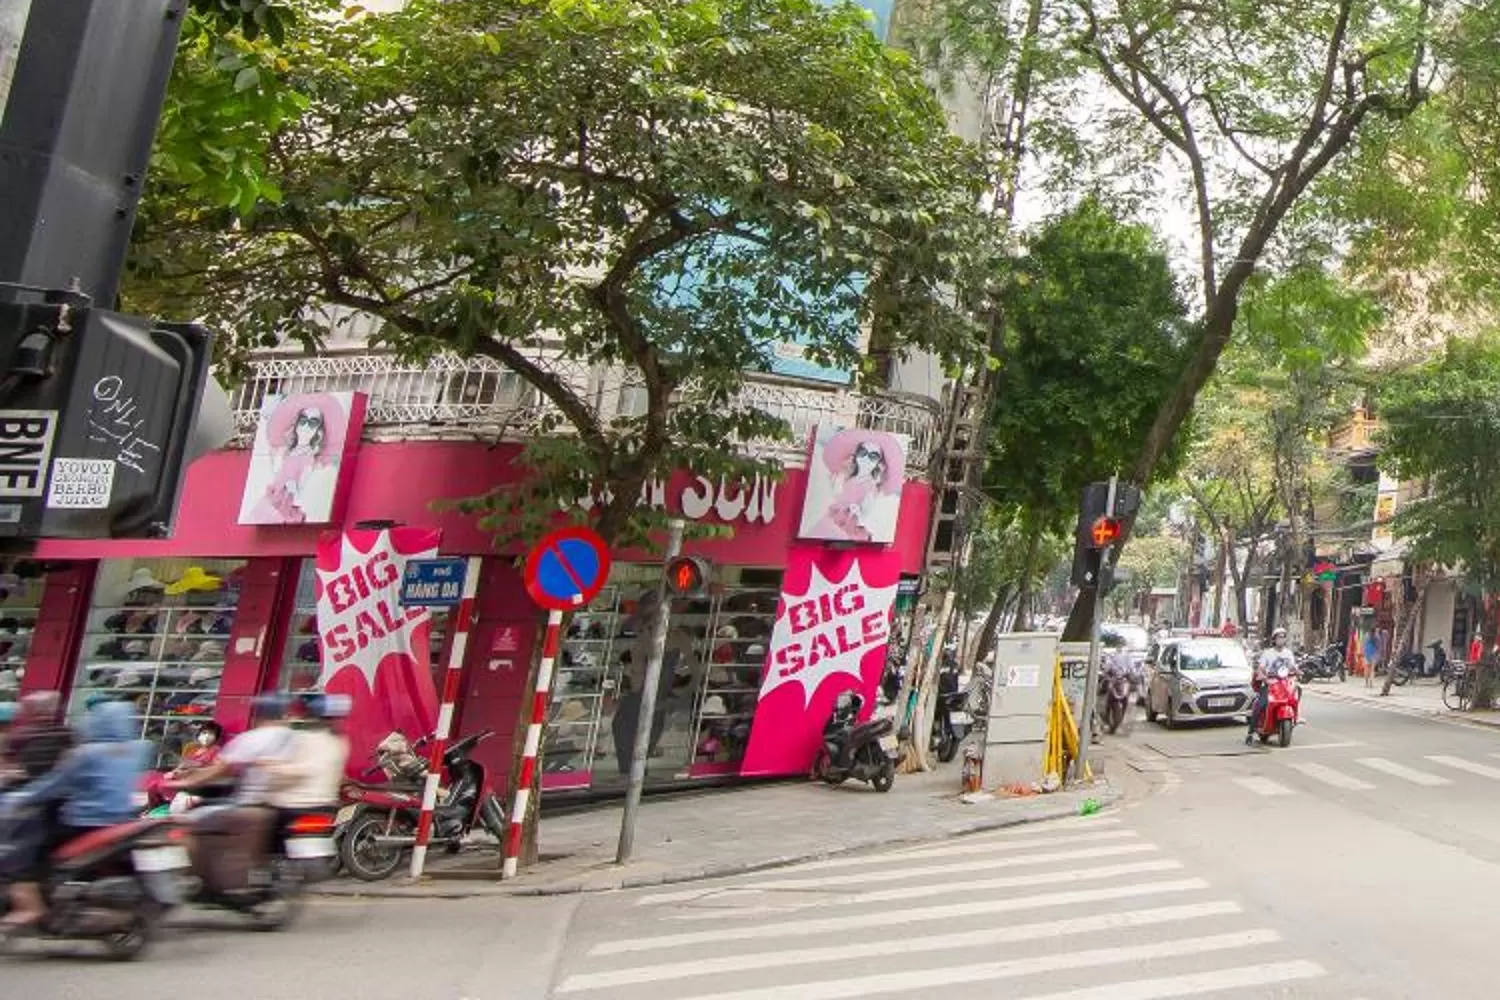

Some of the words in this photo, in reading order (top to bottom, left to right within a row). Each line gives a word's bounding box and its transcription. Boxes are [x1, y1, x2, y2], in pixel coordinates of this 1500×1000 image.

[0, 416, 50, 489] BNE
[326, 551, 398, 614] BIG
[788, 584, 865, 635] BIG
[776, 610, 887, 677] SALE
